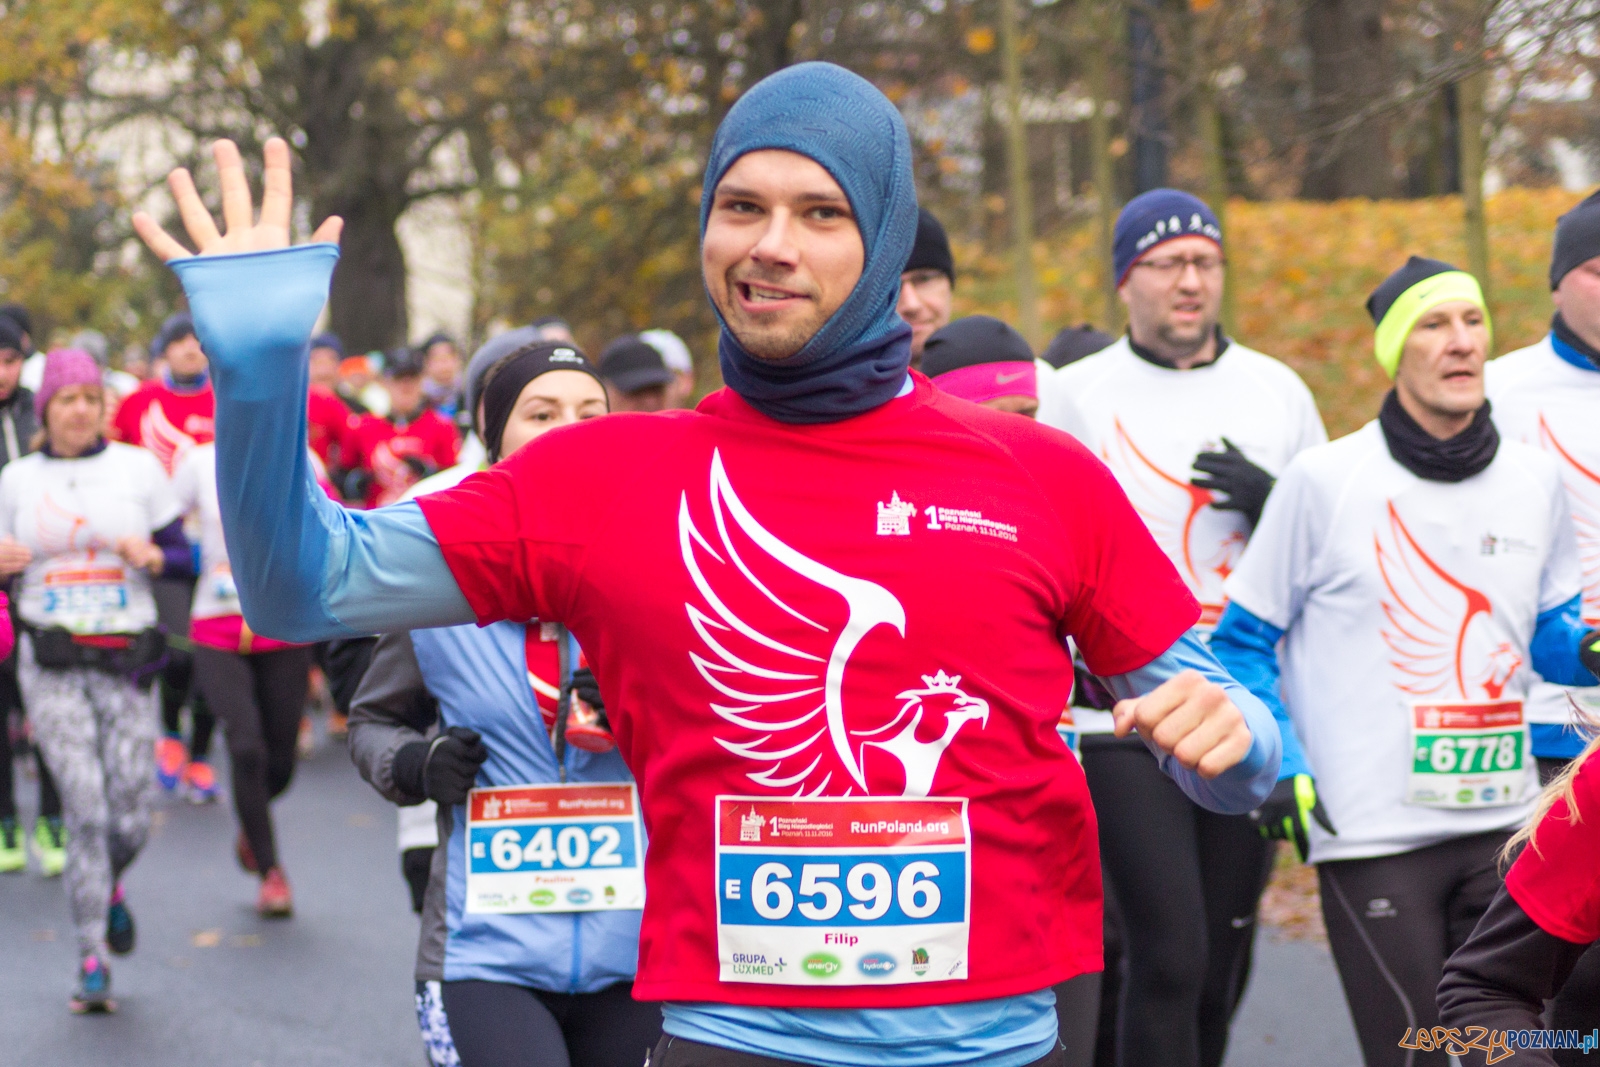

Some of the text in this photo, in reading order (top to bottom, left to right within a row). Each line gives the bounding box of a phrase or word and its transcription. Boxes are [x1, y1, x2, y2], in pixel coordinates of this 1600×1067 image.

[924, 505, 942, 530] 1
[1430, 734, 1516, 772] 6778
[769, 816, 780, 837] 1
[850, 819, 949, 835] RunPoland.org
[472, 825, 623, 870] E 6402
[725, 861, 942, 921] E 6596
[824, 933, 859, 947] Filip
[733, 953, 767, 964] GRUPA
[807, 962, 839, 973] energy
[733, 964, 774, 976] LUXMED
